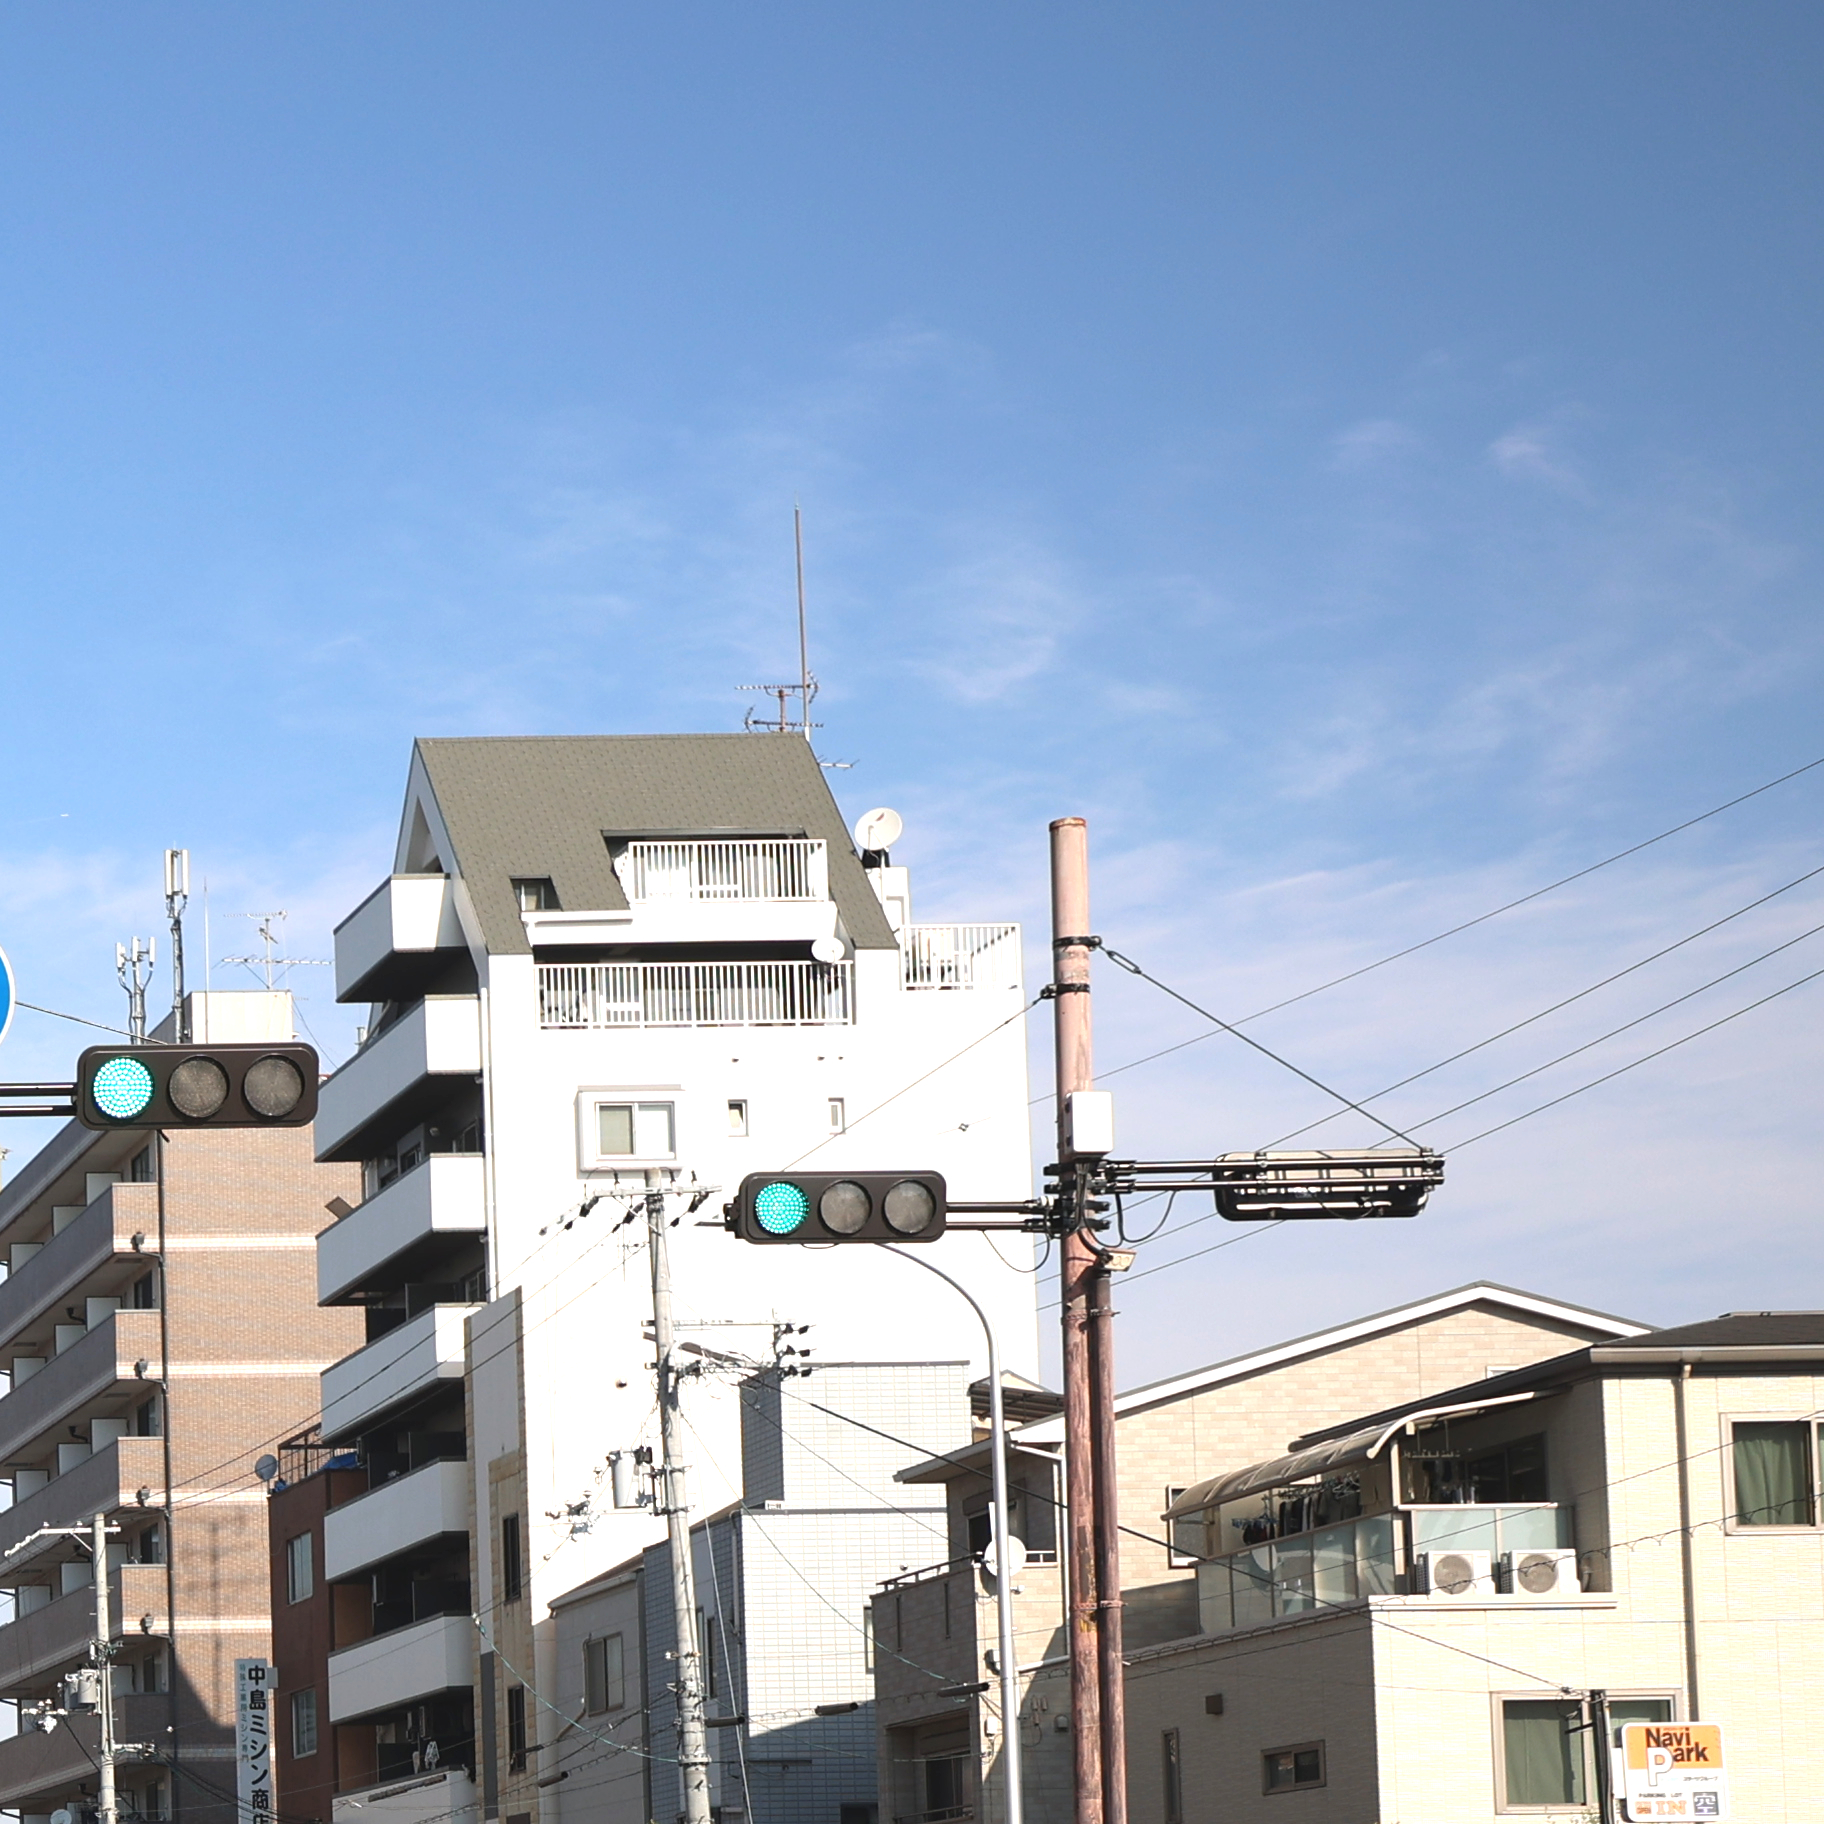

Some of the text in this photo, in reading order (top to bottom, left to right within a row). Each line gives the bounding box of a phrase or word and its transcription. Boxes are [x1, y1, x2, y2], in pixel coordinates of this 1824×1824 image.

[1645, 1727, 1691, 1748] Navi
[1647, 1742, 1709, 1787] Park
[1656, 1800, 1687, 1815] IN
[1695, 1793, 1717, 1815] 空
